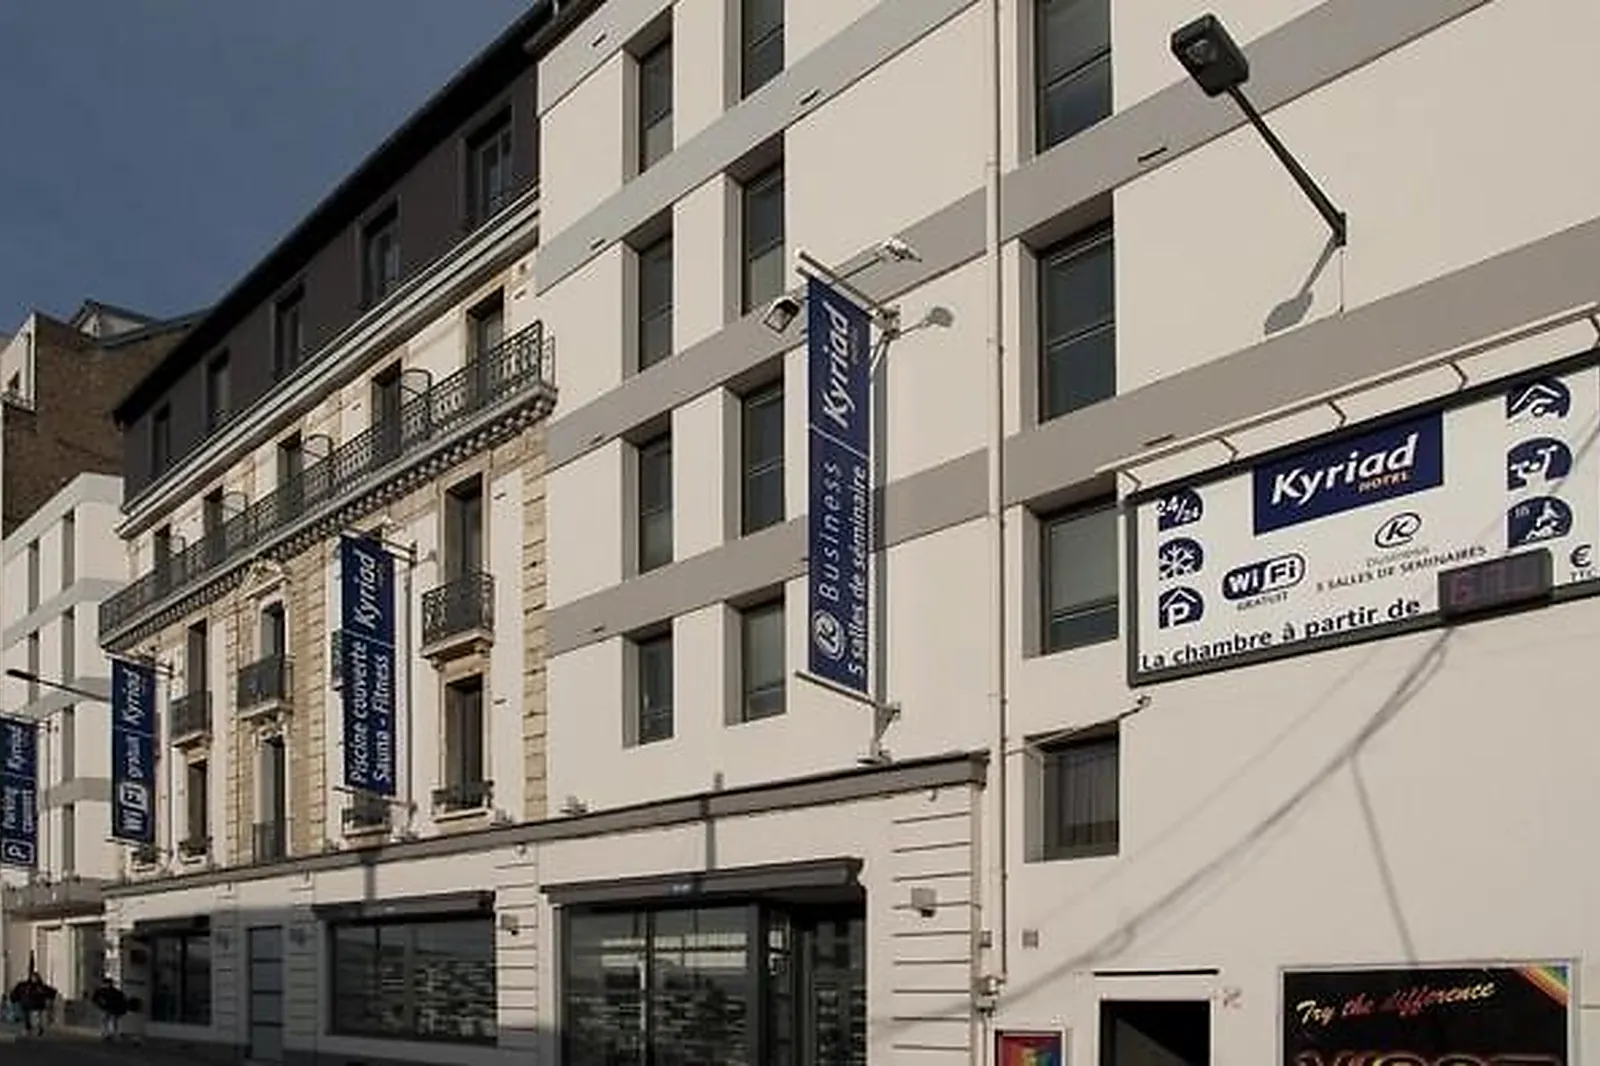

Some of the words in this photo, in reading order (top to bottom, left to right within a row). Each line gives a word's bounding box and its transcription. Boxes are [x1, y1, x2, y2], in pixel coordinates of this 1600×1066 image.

[822, 301, 855, 428] Kyriad
[1271, 432, 1419, 506] Kyriad
[819, 462, 841, 601] Business
[1570, 545, 1591, 567] €
[354, 548, 383, 630] Kyriad
[849, 574, 866, 599] de
[849, 604, 866, 661] salles
[1141, 653, 1166, 670] La
[1172, 633, 1273, 663] chambre
[1282, 622, 1296, 640] à
[1304, 606, 1379, 638] partir
[1387, 598, 1421, 618] de
[1296, 1000, 1336, 1026] Try
